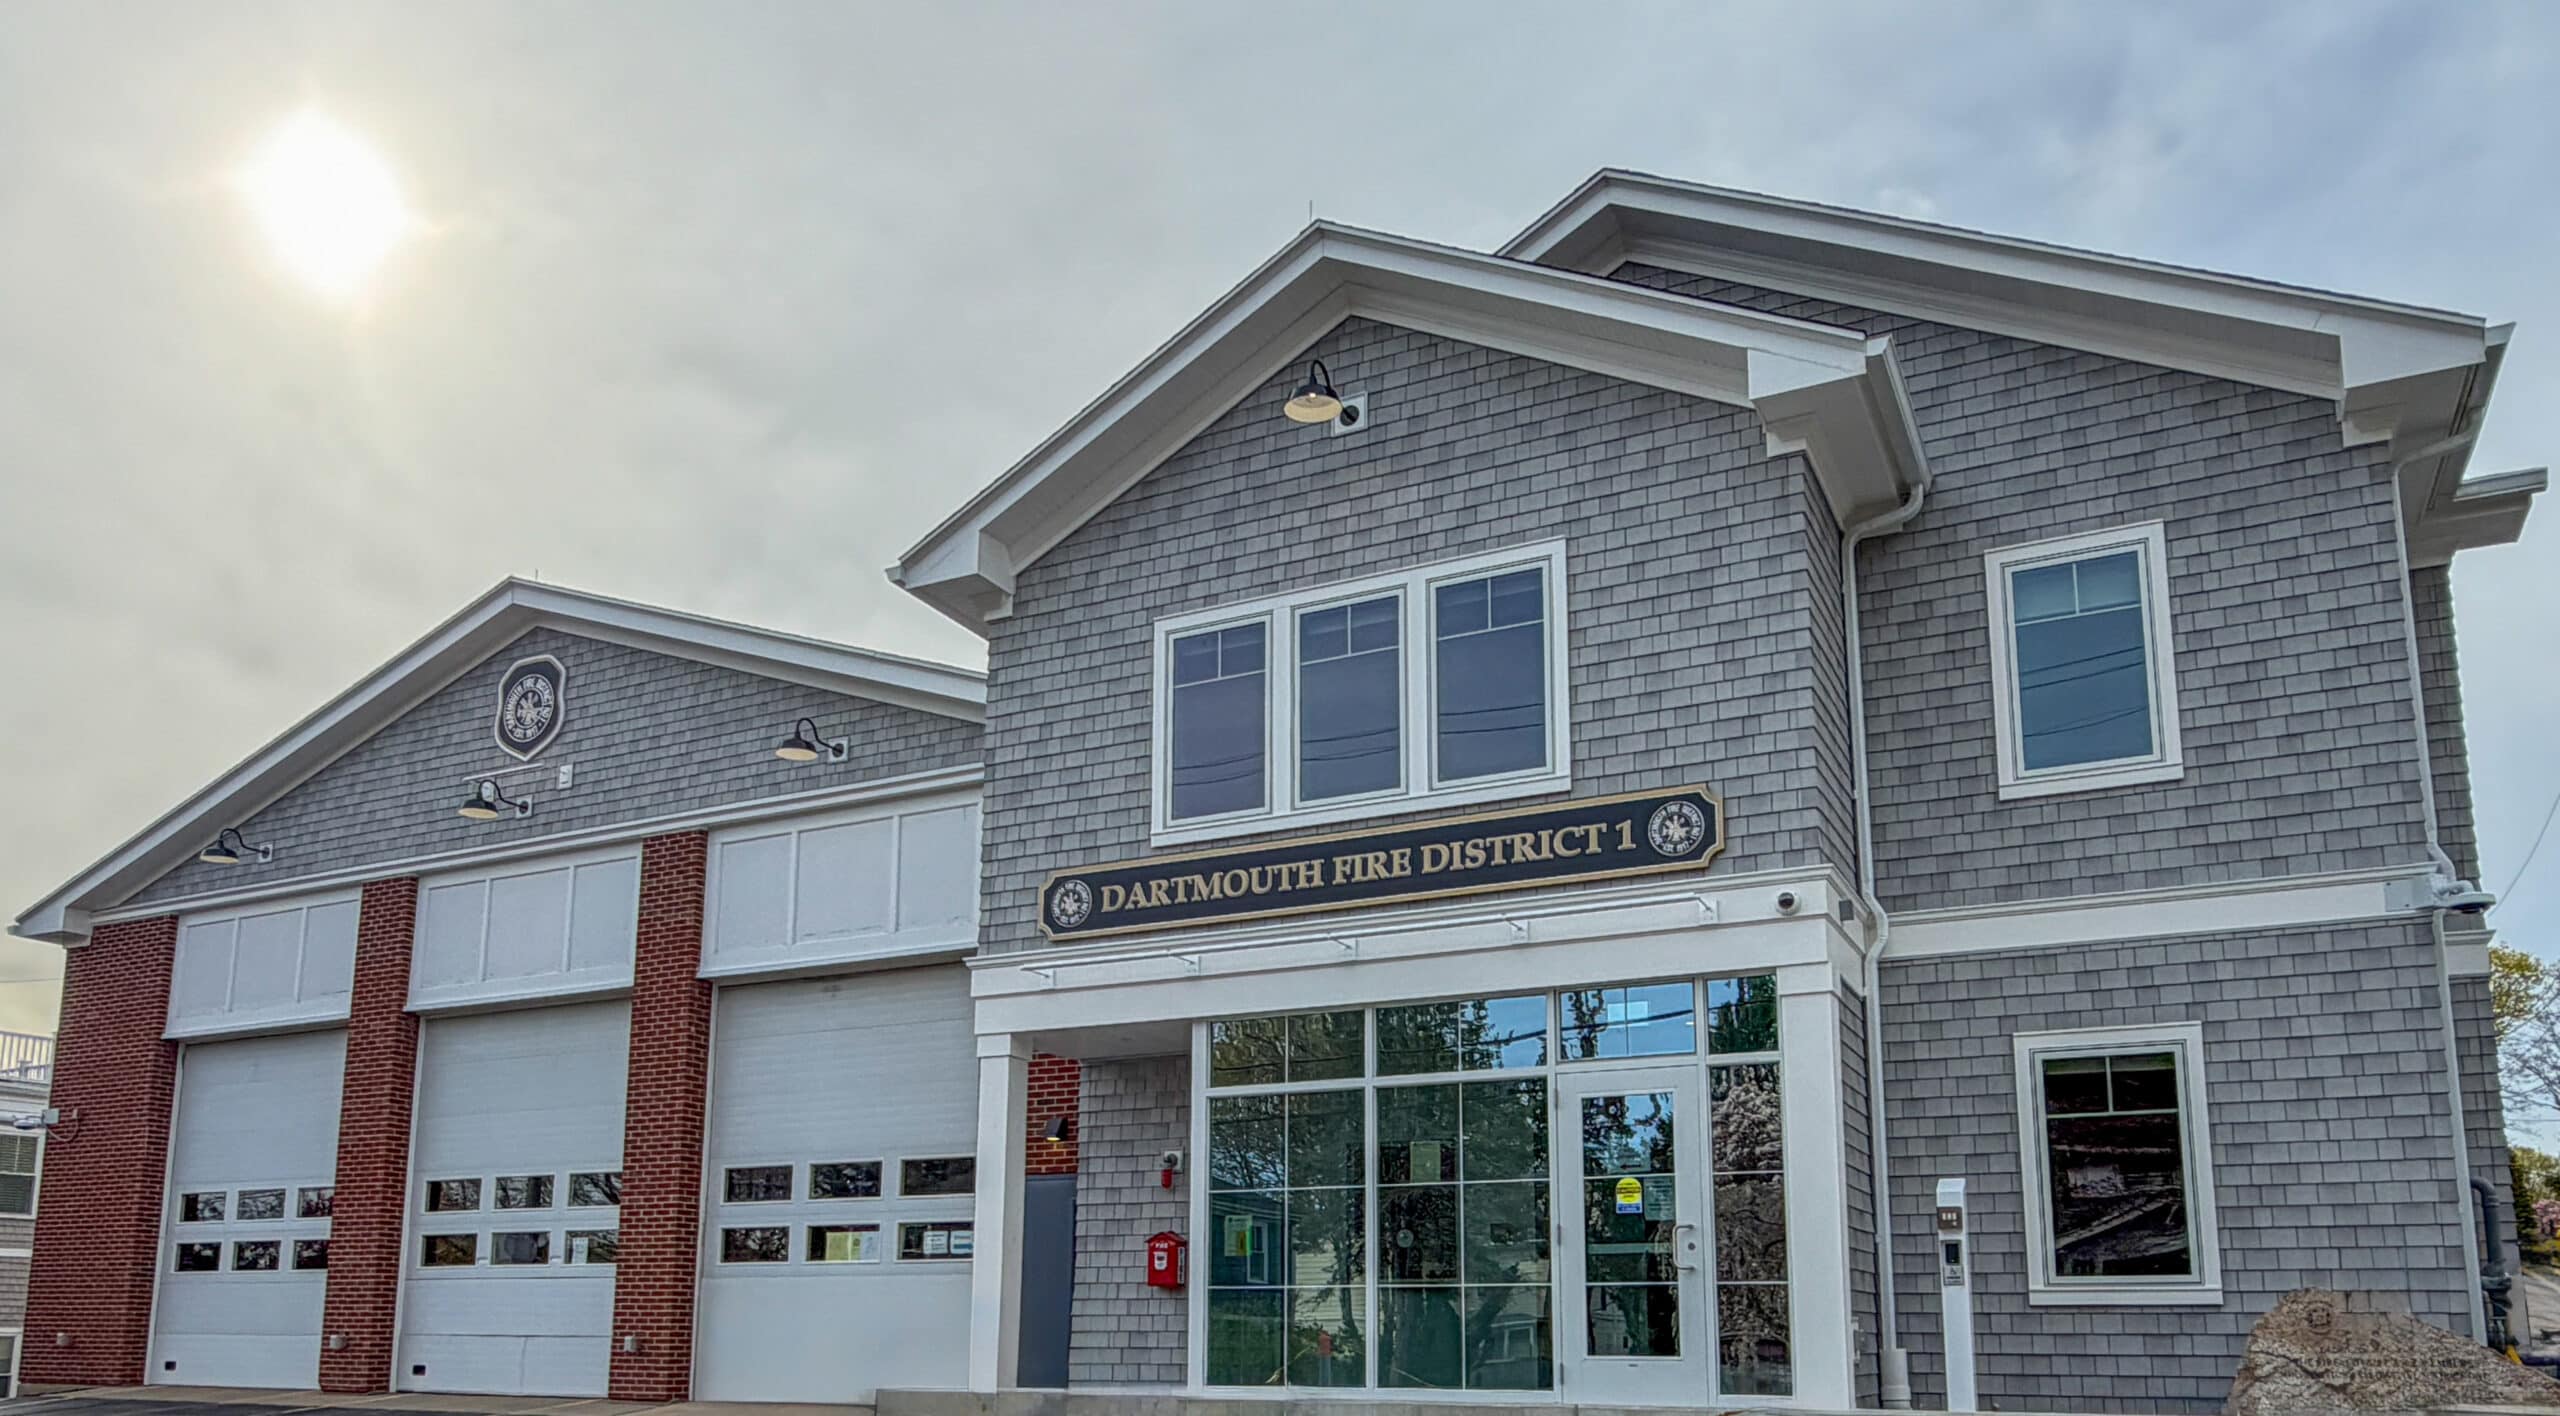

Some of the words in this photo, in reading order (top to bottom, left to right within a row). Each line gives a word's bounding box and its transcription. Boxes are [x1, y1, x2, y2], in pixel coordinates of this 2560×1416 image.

[1100, 858, 1325, 913] DARTMOUTH
[1332, 848, 1412, 886] FIRE
[1421, 822, 1608, 875] DISTRICT
[1615, 819, 1637, 850] 1
